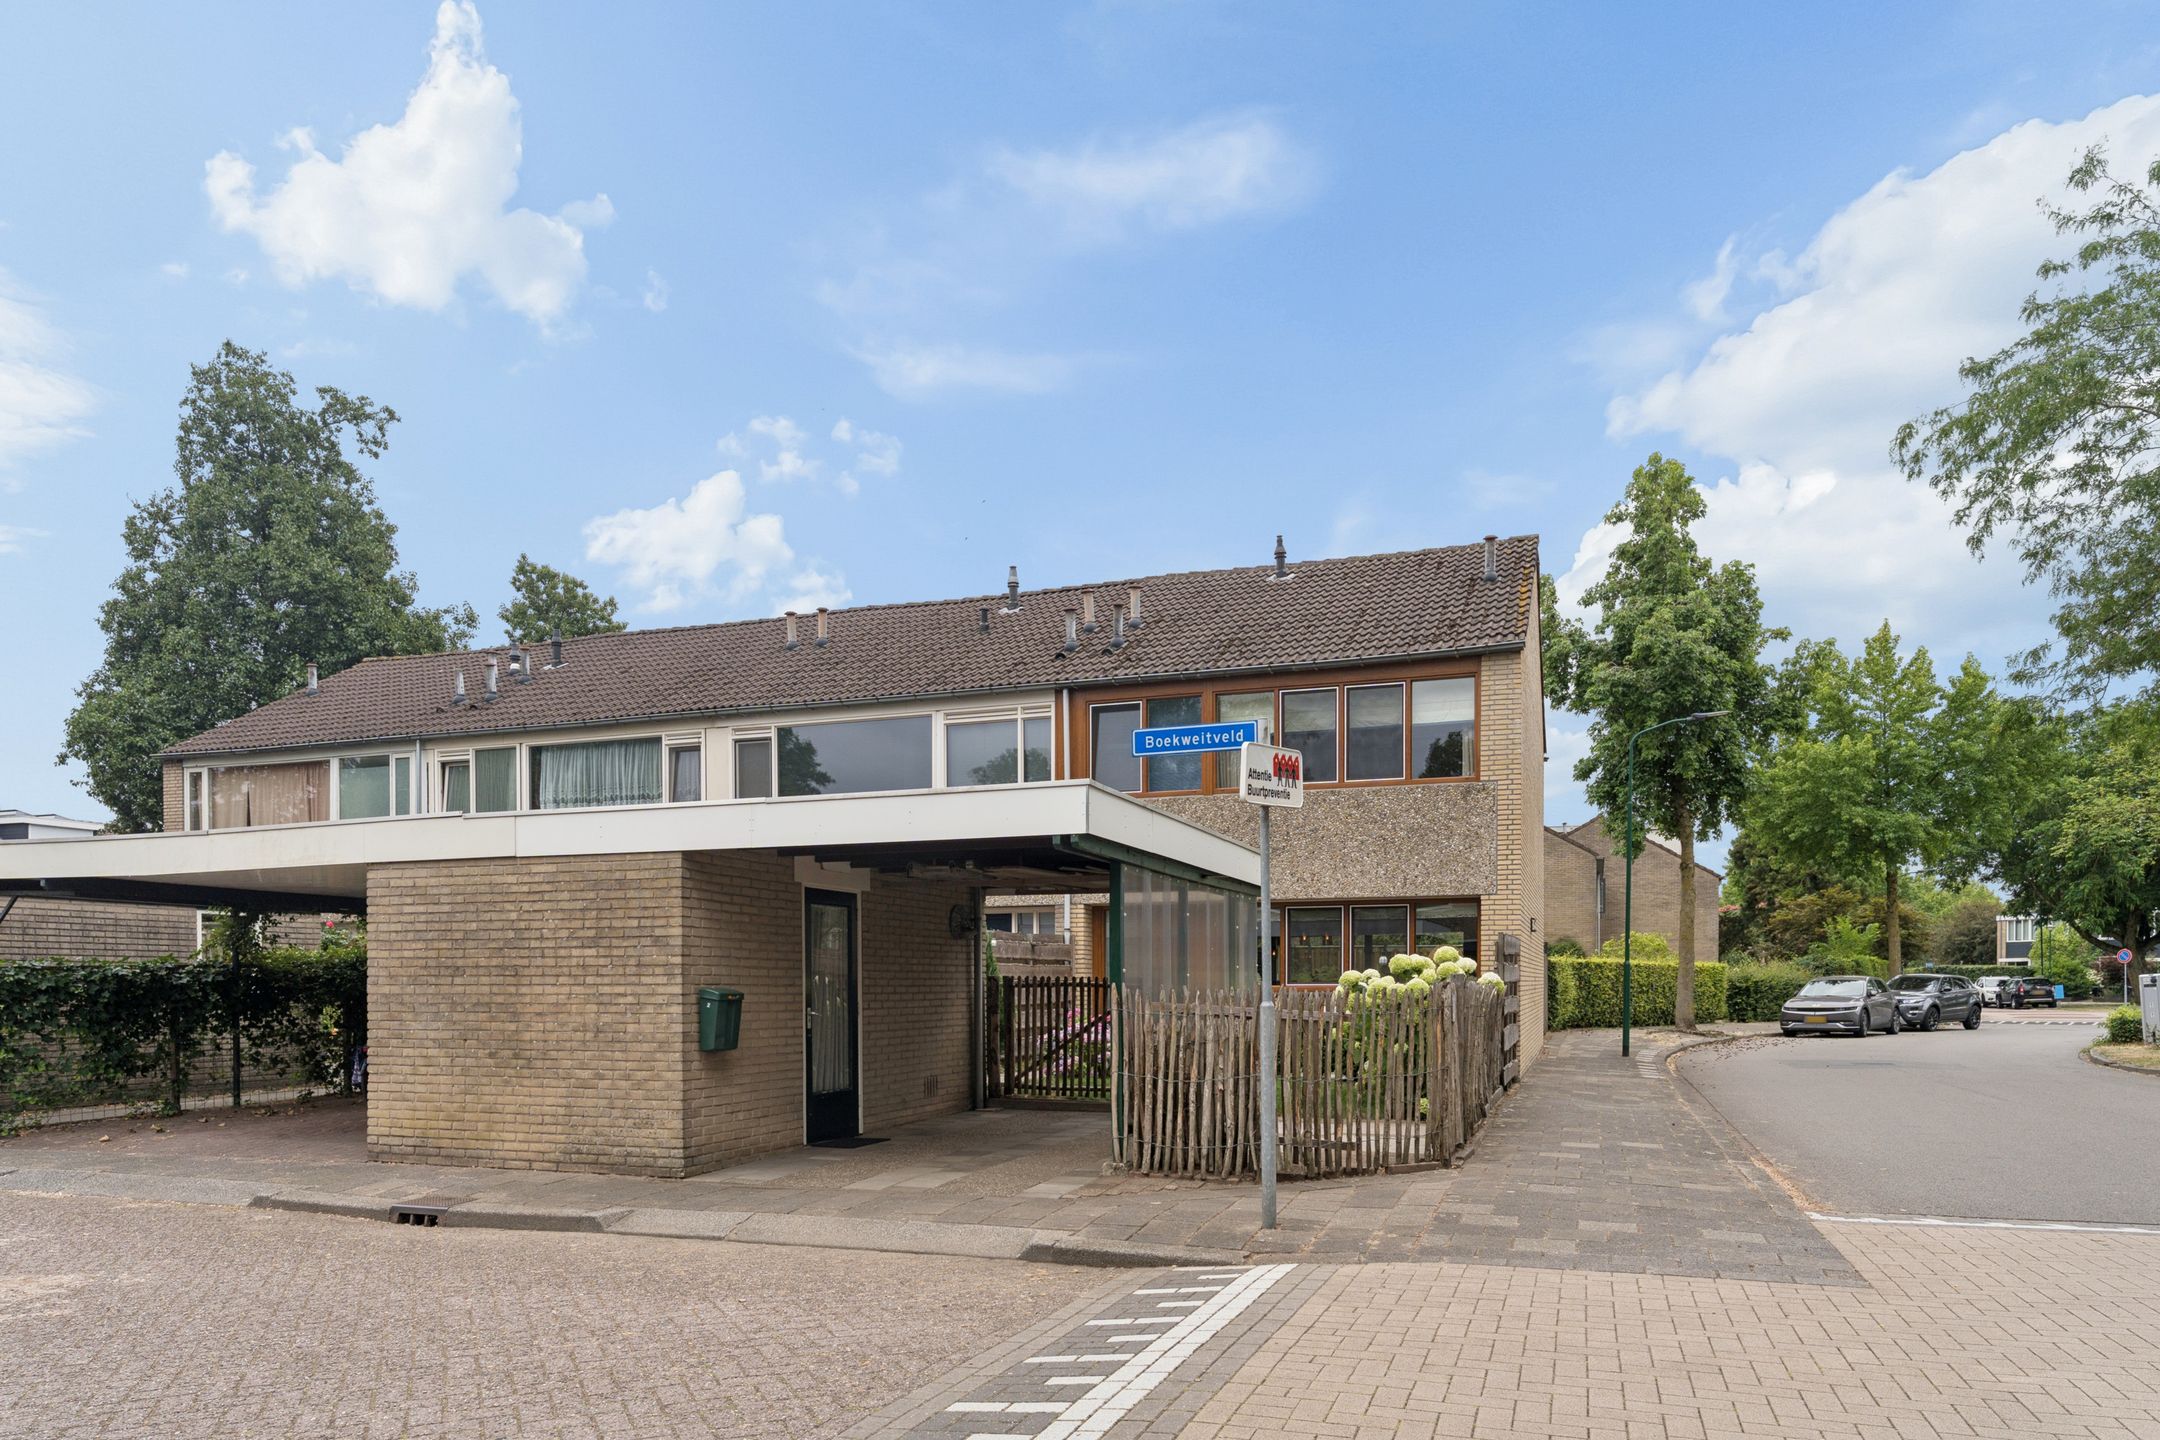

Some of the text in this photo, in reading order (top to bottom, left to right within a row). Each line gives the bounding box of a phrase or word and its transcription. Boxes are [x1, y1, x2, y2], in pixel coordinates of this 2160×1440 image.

[1145, 729, 1244, 748] Boekweitveld
[1247, 767, 1272, 782] Attentie
[1247, 783, 1291, 800] Buurtpreventie
